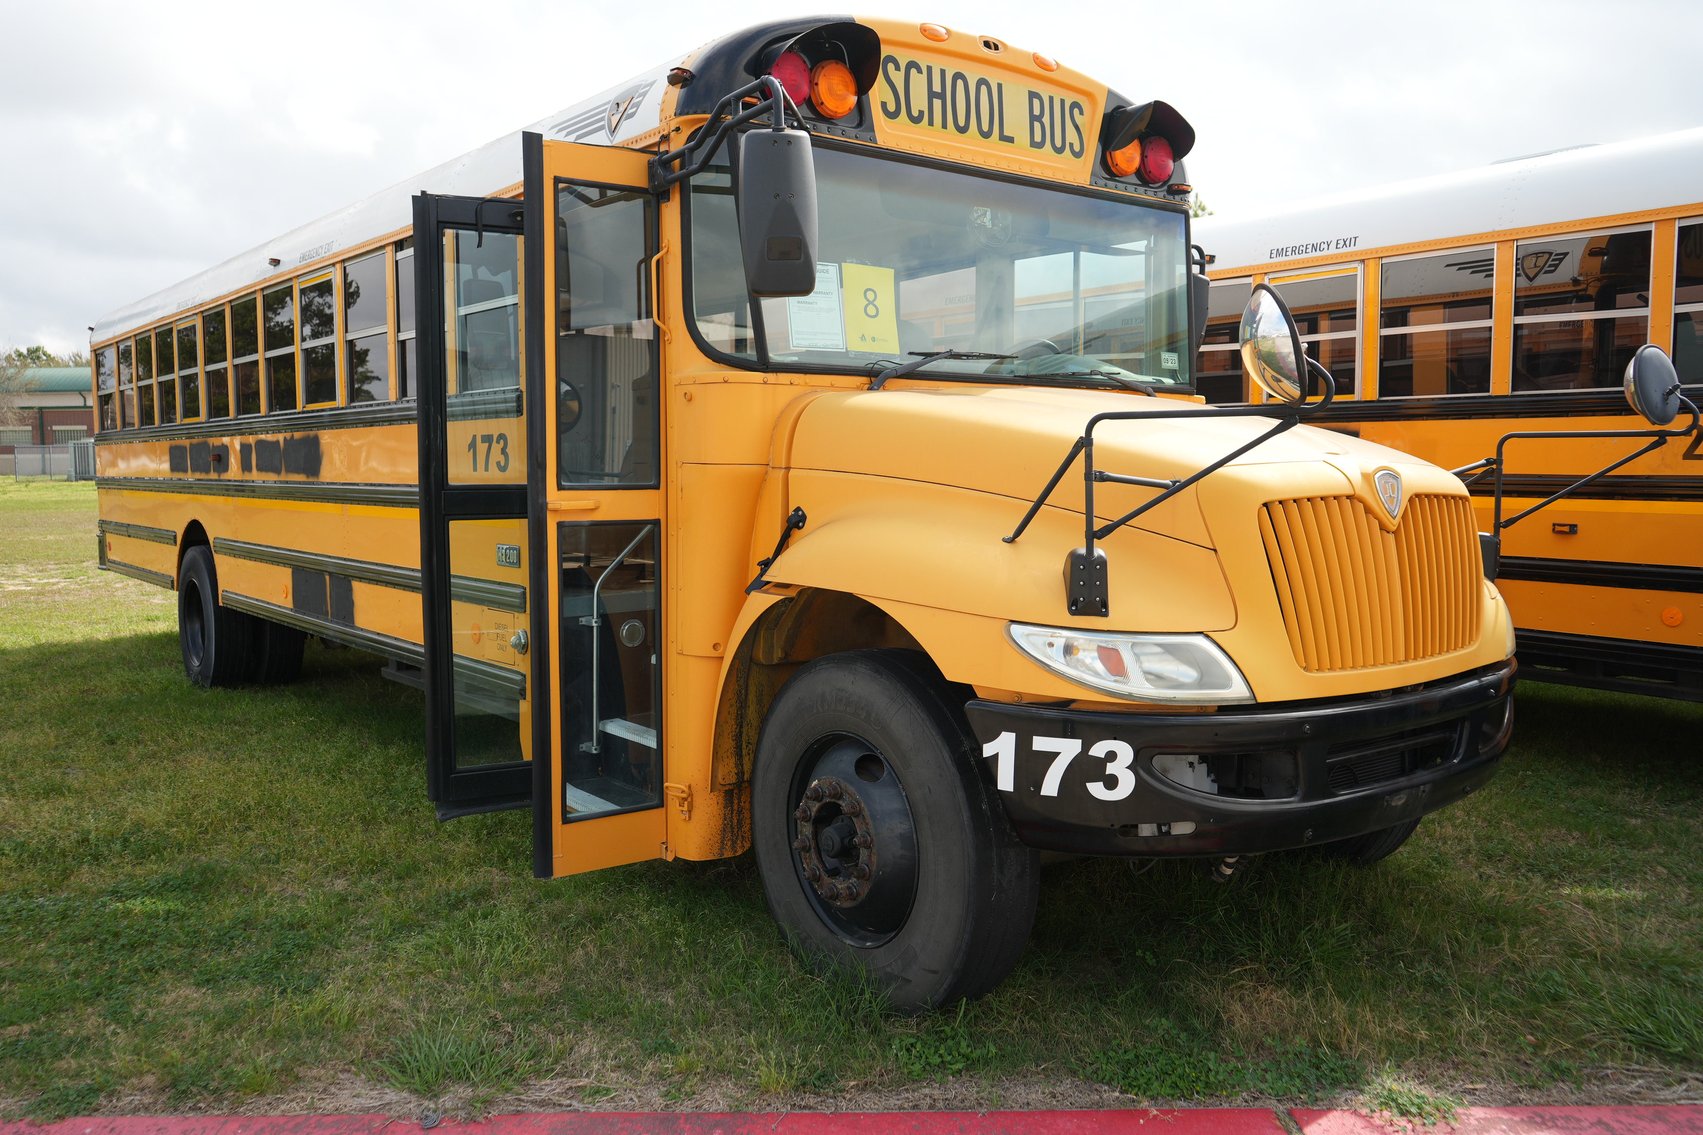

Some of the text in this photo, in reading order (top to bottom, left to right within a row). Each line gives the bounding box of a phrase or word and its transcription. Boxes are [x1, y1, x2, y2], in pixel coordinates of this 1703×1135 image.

[880, 54, 1085, 160] SCHOOL BUS
[1269, 236, 1359, 259] EMERGENCY EXIT
[863, 287, 880, 319] 8
[467, 432, 510, 474] 173
[982, 731, 1136, 801] 173
